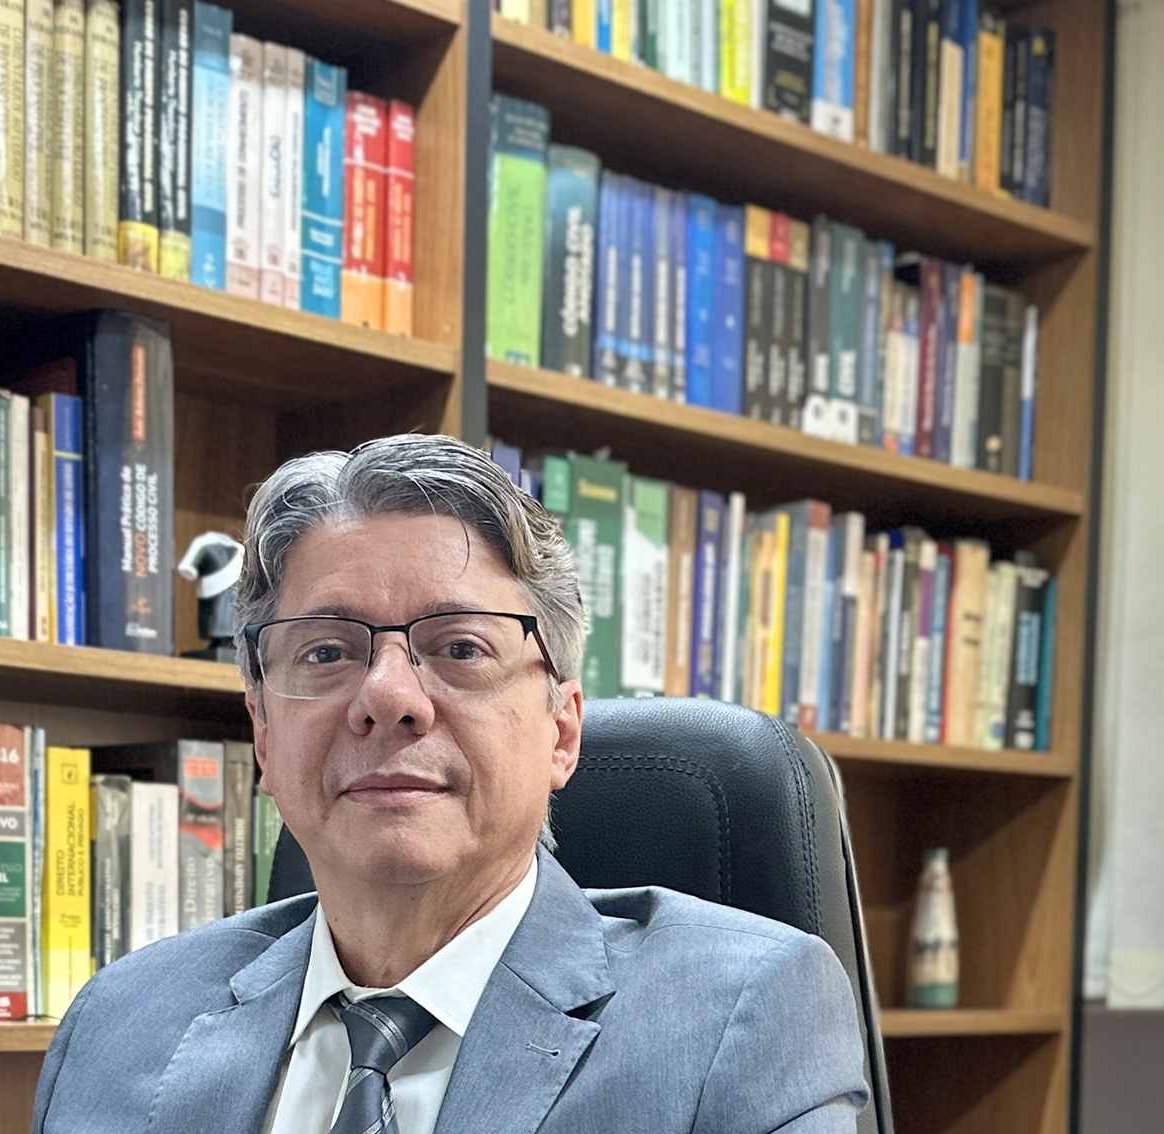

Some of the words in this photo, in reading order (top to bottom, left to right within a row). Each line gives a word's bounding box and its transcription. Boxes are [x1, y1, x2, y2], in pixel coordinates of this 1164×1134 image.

[121, 465, 132, 482] do
[135, 463, 147, 482] DE
[147, 473, 158, 505] CIVIL
[120, 483, 132, 526] Prático
[134, 483, 147, 531] CÓDIGO
[121, 528, 133, 572] Manual
[134, 533, 147, 577] NOVO
[147, 506, 159, 573] PROCESSO
[66, 801, 76, 896] INTERNACIONAL
[56, 849, 66, 896] DIREITO
[183, 856, 197, 913] Direito
[202, 857, 216, 921] istrativo
